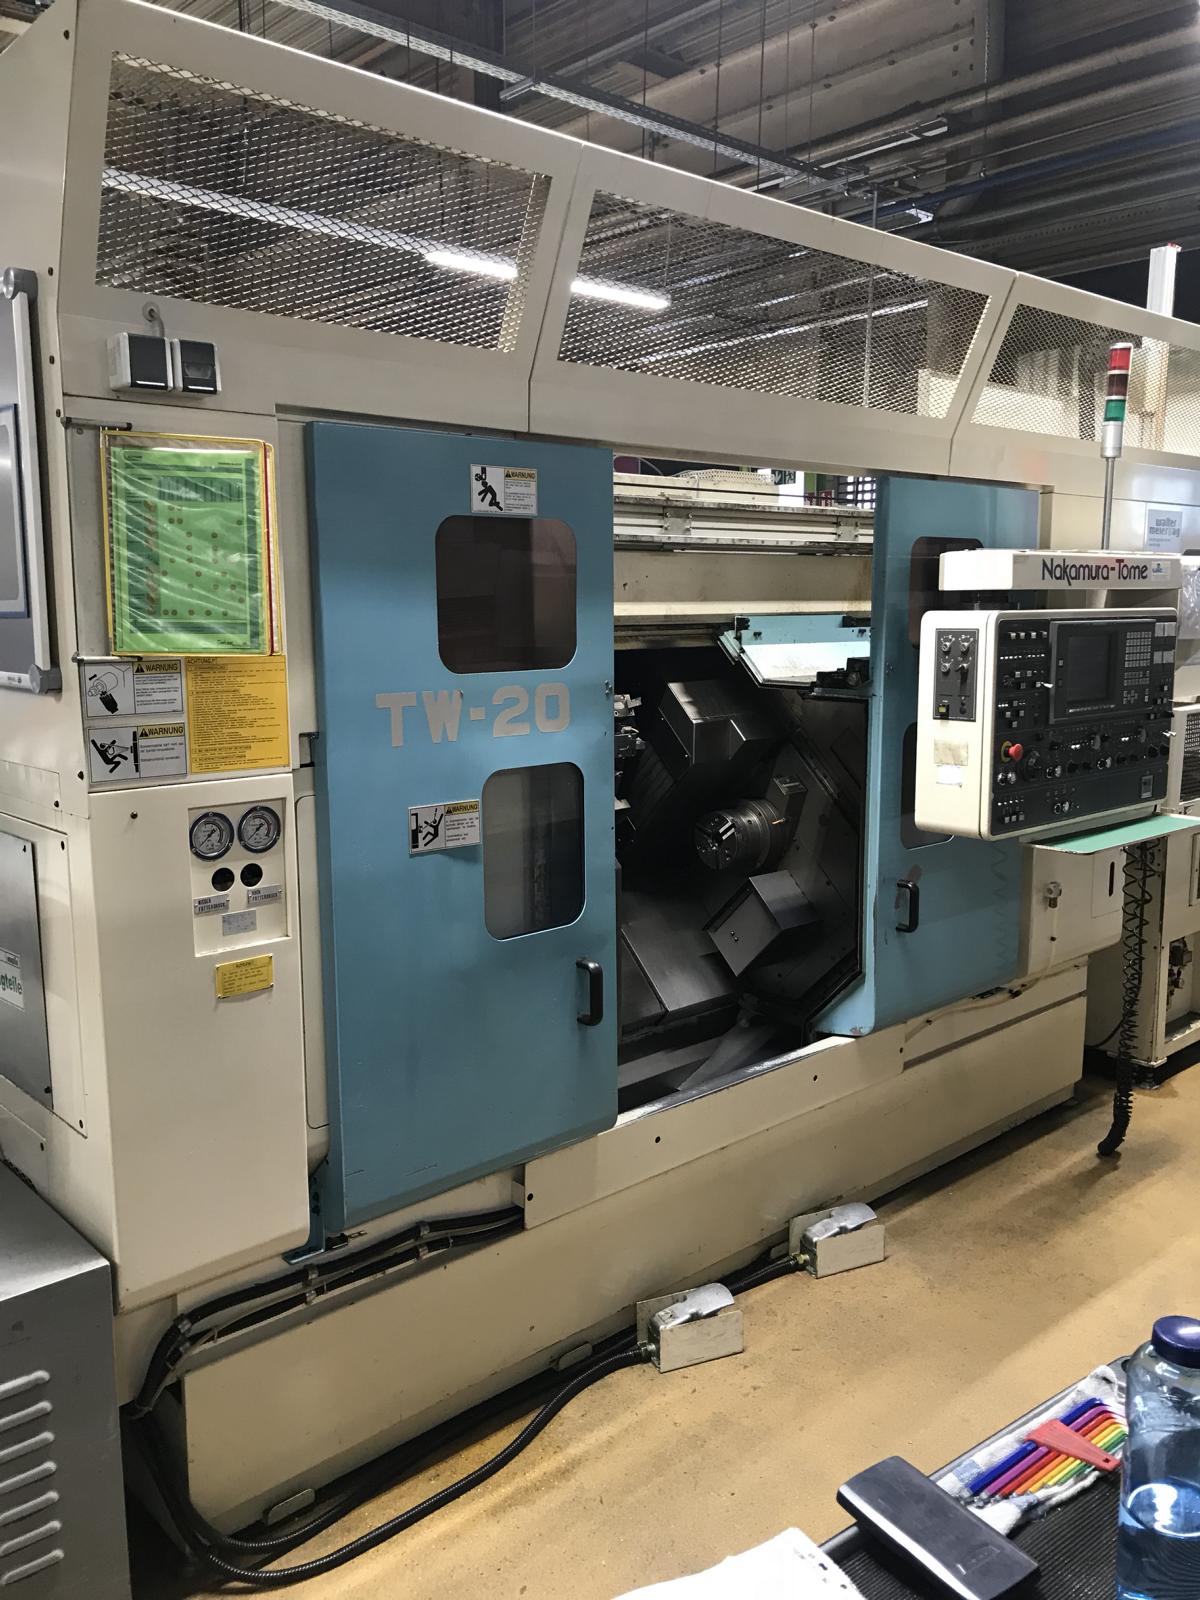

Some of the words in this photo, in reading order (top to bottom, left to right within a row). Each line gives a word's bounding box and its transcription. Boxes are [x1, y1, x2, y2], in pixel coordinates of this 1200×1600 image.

[511, 471, 536, 480] WARNUNG
[1042, 558, 1148, 586] Nakamura-Tome
[145, 663, 178, 672] WARNUNG
[375, 682, 571, 747] TW-20
[147, 726, 184, 736] WARNUNG
[451, 803, 478, 813] WARNUNG
